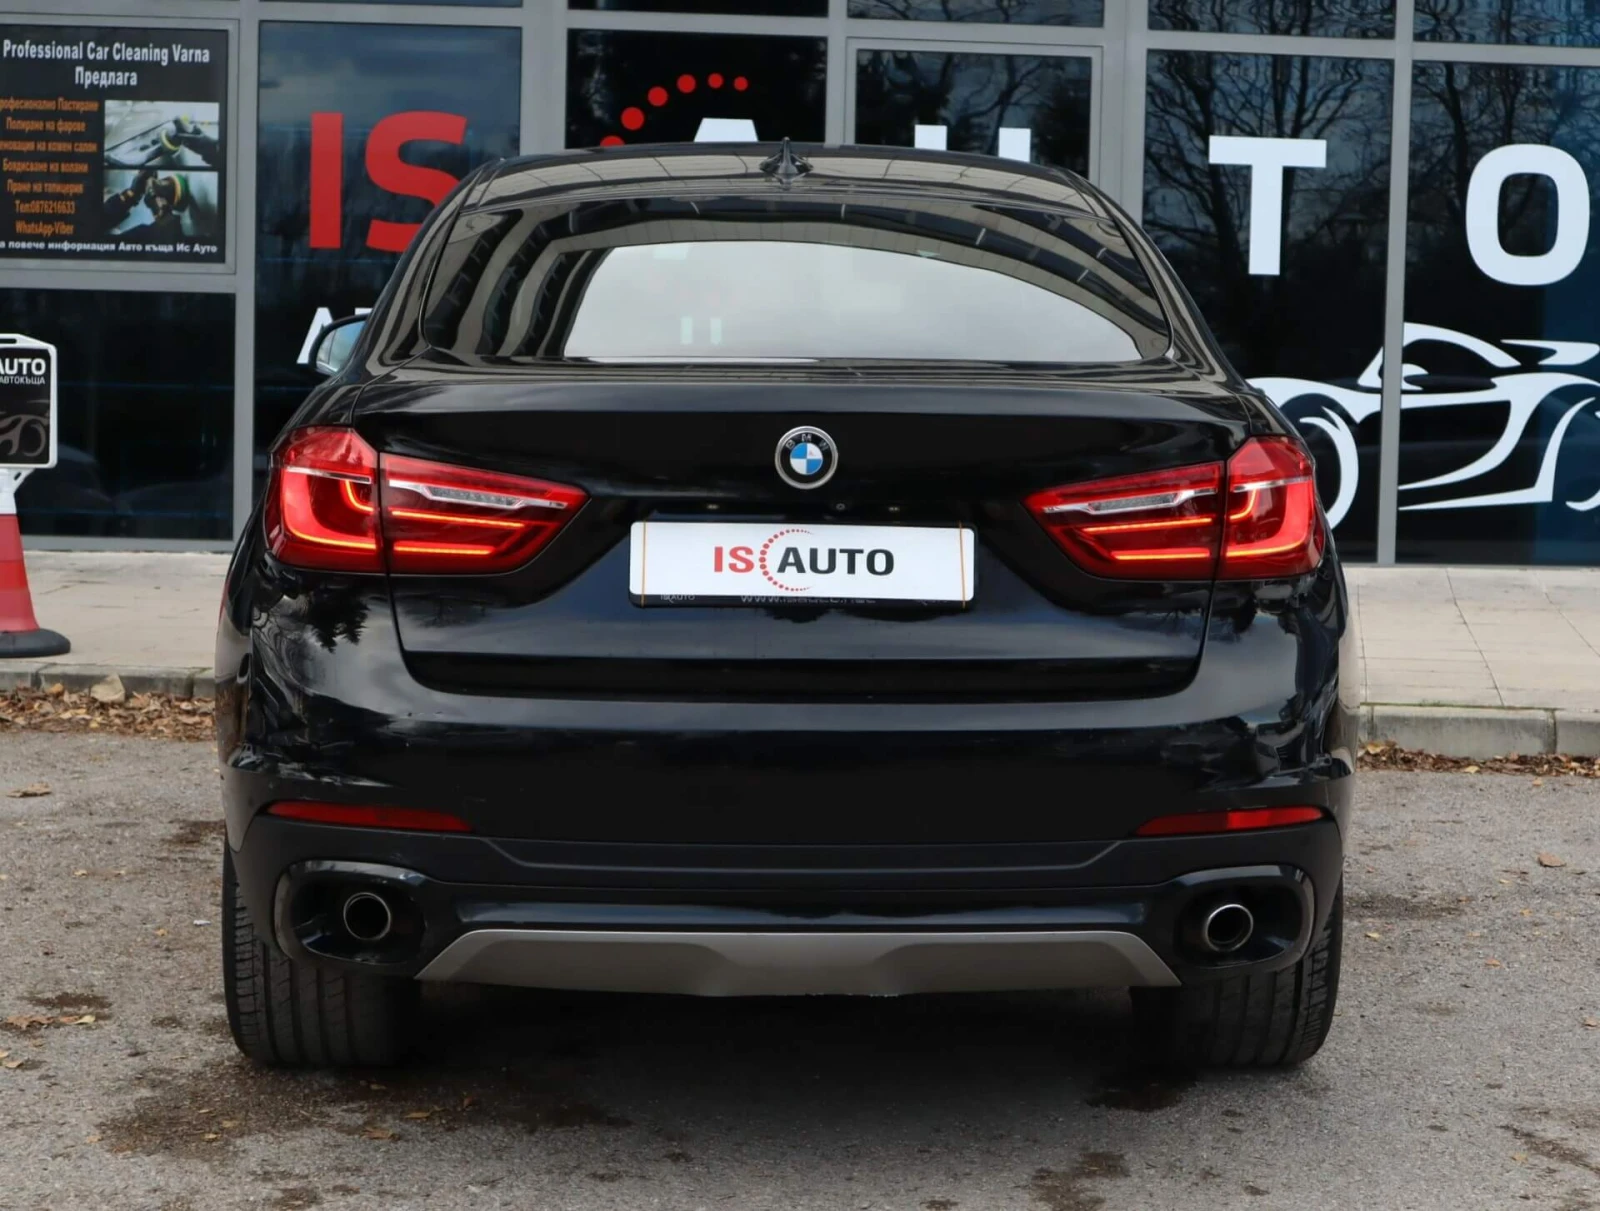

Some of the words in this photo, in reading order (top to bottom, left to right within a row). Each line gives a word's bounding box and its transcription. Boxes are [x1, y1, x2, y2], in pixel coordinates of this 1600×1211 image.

[3, 39, 83, 59] Professional
[87, 41, 109, 60] Car
[112, 42, 168, 66] Cleaning
[172, 44, 210, 63] Varna
[75, 66, 138, 88] Предлага
[6, 116, 44, 134] Полиране
[45, 121, 55, 132] на
[57, 118, 86, 135] фарове
[36, 141, 46, 152] на
[49, 162, 59, 172] на
[7, 179, 31, 194] Пране
[32, 182, 42, 193] на
[309, 111, 467, 252] IS
[8, 241, 46, 250] повече
[47, 240, 116, 252] информация
[118, 242, 143, 252] Авто
[145, 243, 173, 253] къща
[176, 242, 191, 253] Ис
[193, 243, 218, 254] Ауто
[785, 433, 829, 451] BMW
[713, 545, 755, 573] IS
[776, 546, 895, 576] AUTO
